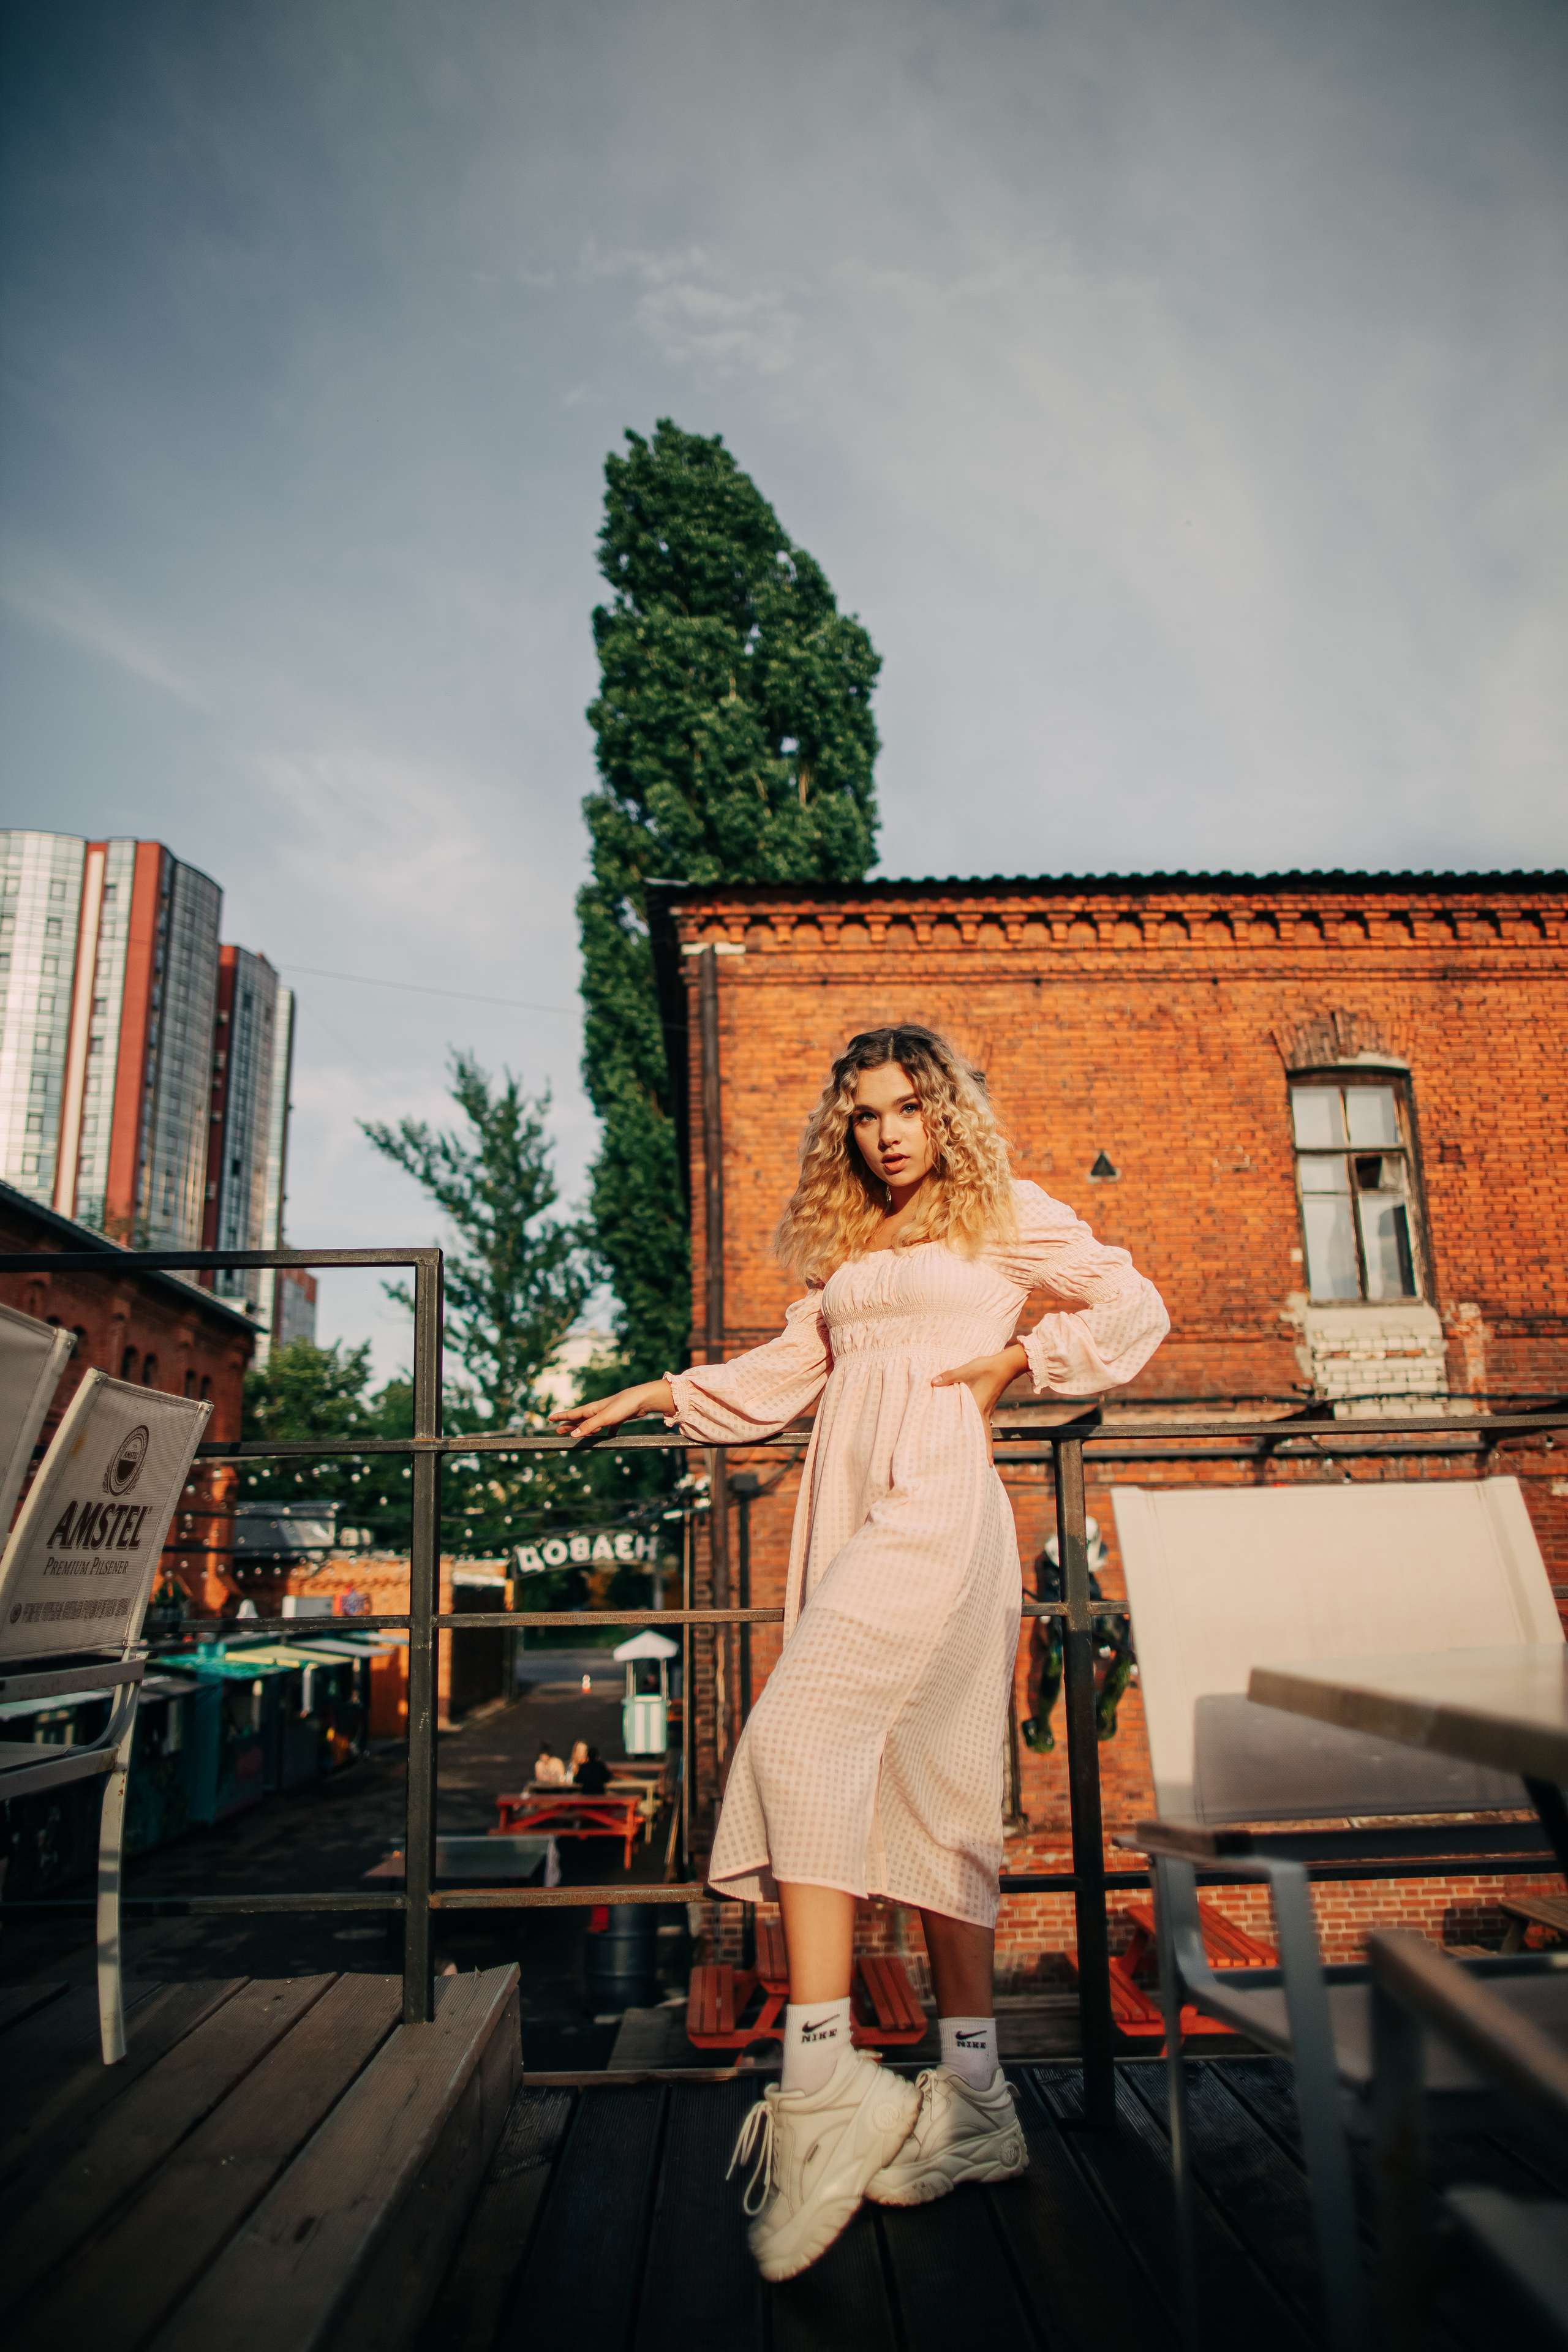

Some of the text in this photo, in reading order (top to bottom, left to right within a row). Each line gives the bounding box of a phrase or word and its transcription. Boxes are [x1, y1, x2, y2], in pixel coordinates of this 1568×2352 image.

[47, 1500, 149, 1550] AMSTEL
[43, 1557, 129, 1575] PREMIUM PILSENER
[801, 2028, 837, 2044] NIKE
[956, 2040, 986, 2049] NIKE
